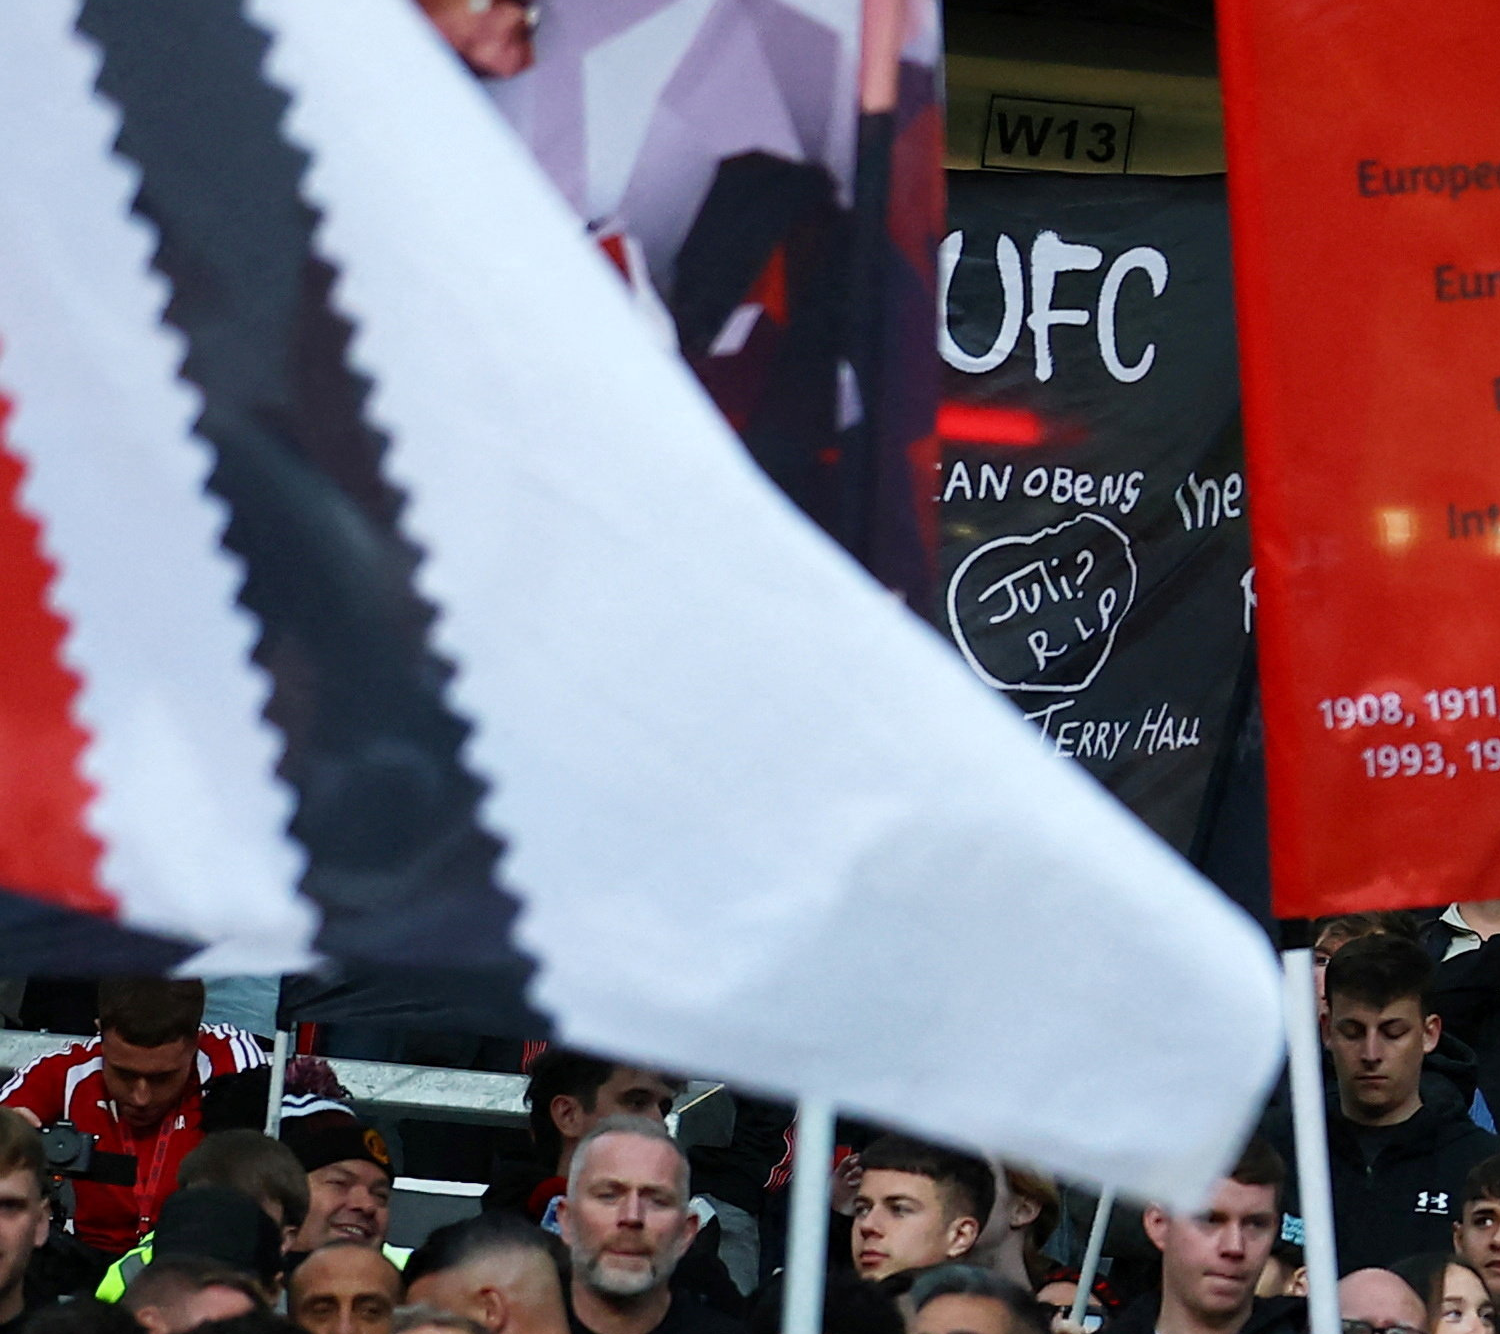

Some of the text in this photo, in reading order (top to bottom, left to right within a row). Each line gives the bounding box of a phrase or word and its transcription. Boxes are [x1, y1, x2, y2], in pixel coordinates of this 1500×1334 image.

[993, 114, 1118, 164] W13
[933, 460, 1013, 503] AN
[1023, 699, 1131, 762] TERRY
[1318, 691, 1415, 731] 1908,
[1361, 741, 1458, 779] 1993,
